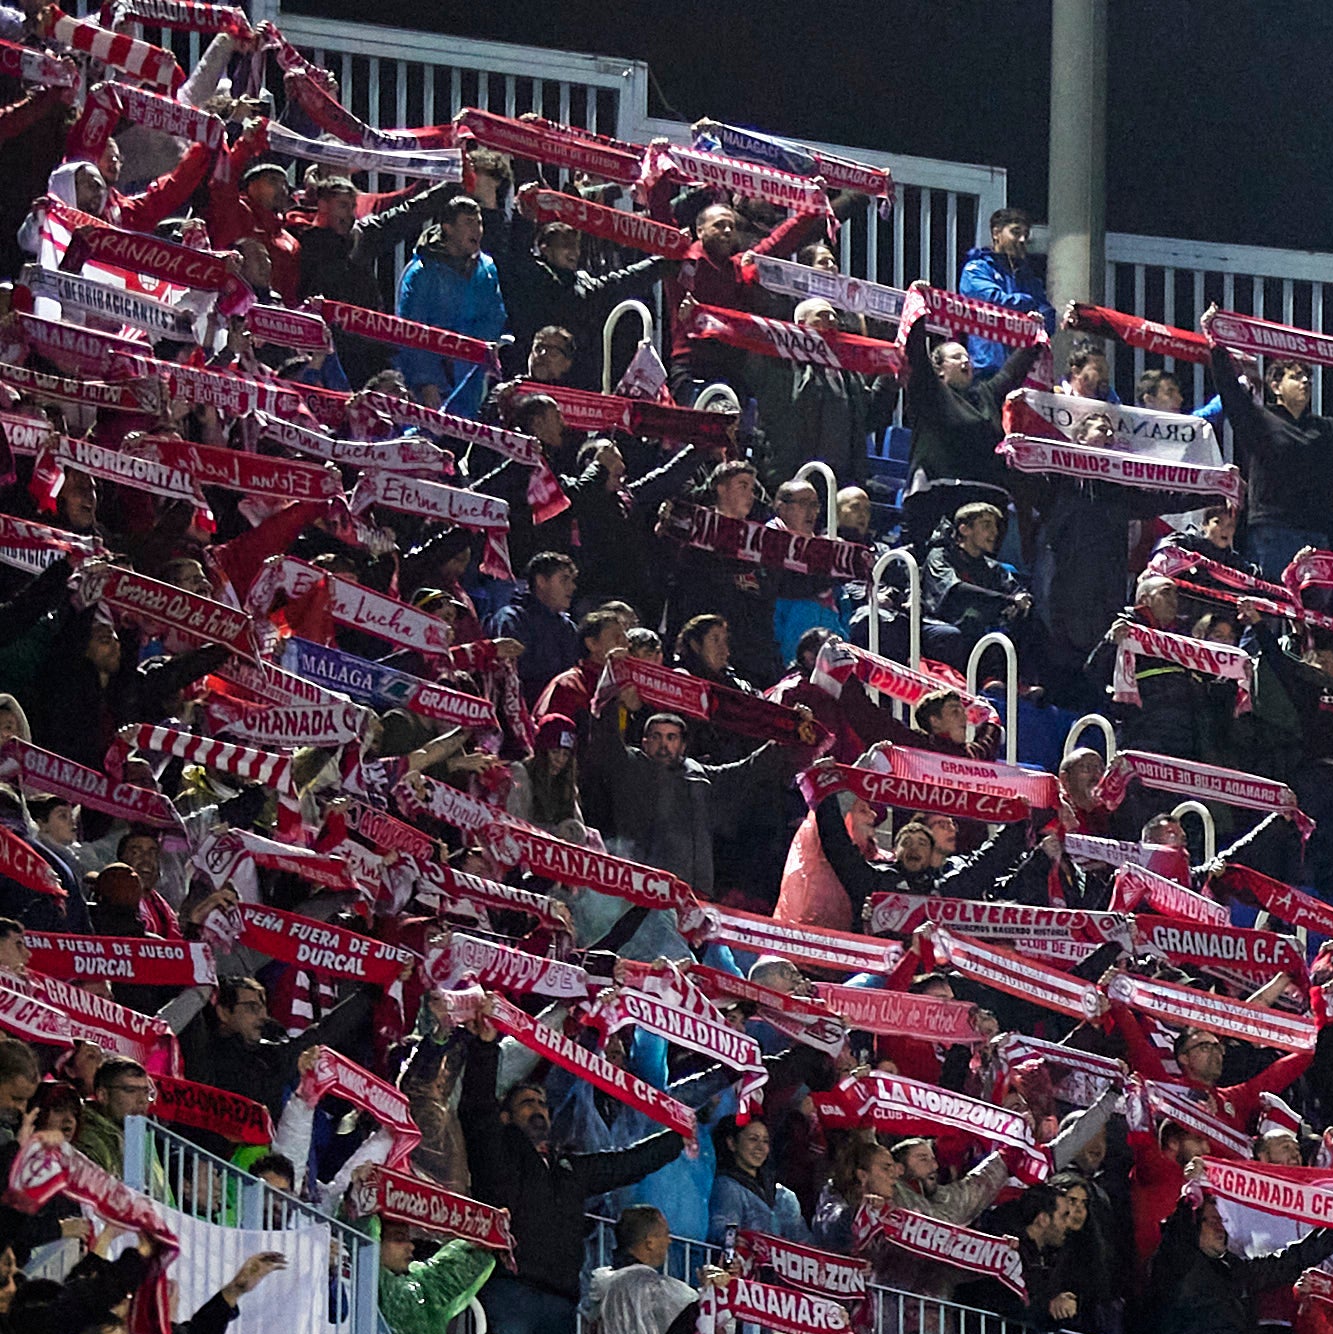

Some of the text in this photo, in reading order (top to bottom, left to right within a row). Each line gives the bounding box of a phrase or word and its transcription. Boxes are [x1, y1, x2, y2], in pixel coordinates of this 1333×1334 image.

[679, 159, 699, 177] YO
[702, 163, 729, 186] SOY
[731, 170, 756, 191] DEL
[85, 231, 219, 284] GRANADA C.F.
[334, 300, 430, 341] GRANADA
[382, 476, 508, 522] Eterna Lucha
[302, 653, 374, 691] MÁLAGA
[419, 689, 491, 720] GRANADA
[23, 749, 108, 798] GRANADA
[941, 760, 998, 779] GRANADA
[864, 775, 1012, 816] GRANADA C.F.
[244, 909, 372, 956] PEÑA FUERA DE
[1153, 926, 1289, 966] GRANADA C.F.
[74, 955, 135, 978] DURCAL
[297, 945, 366, 976] DURCAL
[46, 979, 128, 1024] GRANADA
[534, 1021, 628, 1088] GRANADA
[877, 1078, 903, 1102] LA
